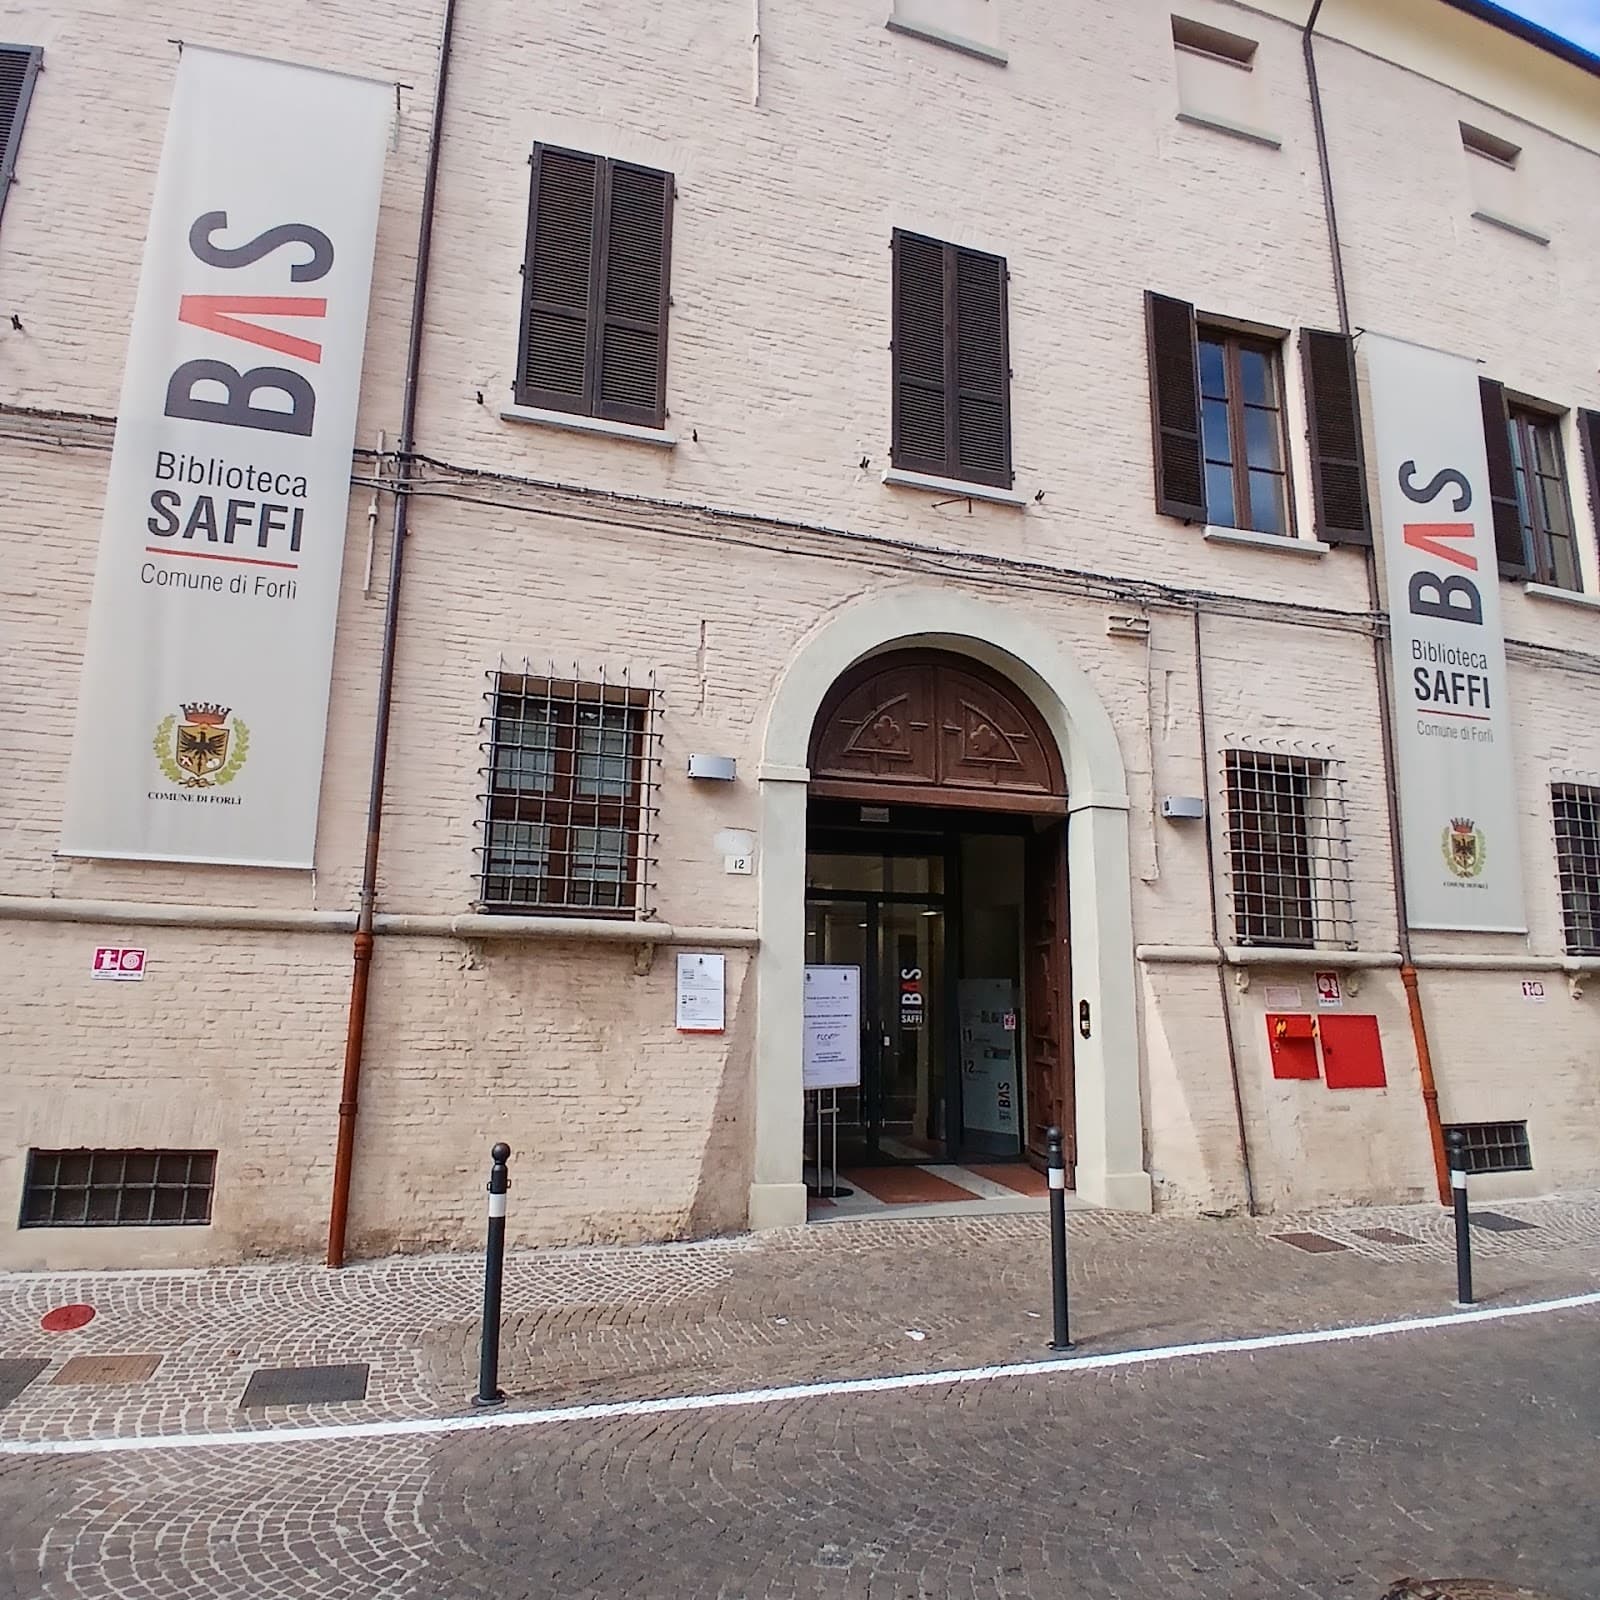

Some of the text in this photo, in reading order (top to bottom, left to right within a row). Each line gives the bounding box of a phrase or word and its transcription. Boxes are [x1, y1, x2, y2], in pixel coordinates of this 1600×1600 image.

[164, 210, 335, 437] BAS
[155, 450, 308, 498] Biblioteca
[147, 489, 304, 552] SAFFI
[1398, 460, 1483, 626] BAS
[141, 563, 298, 600] Comune di Forlì
[1411, 639, 1488, 670] Biblioteca
[1413, 667, 1490, 709] SAFFI
[1416, 720, 1458, 739] Comune
[1460, 726, 1470, 741] di
[147, 791, 194, 803] COMUNE
[196, 795, 208, 804] DI
[734, 859, 745, 870] 12
[901, 969, 922, 1004] BAS
[901, 1014, 923, 1024] SAFFI
